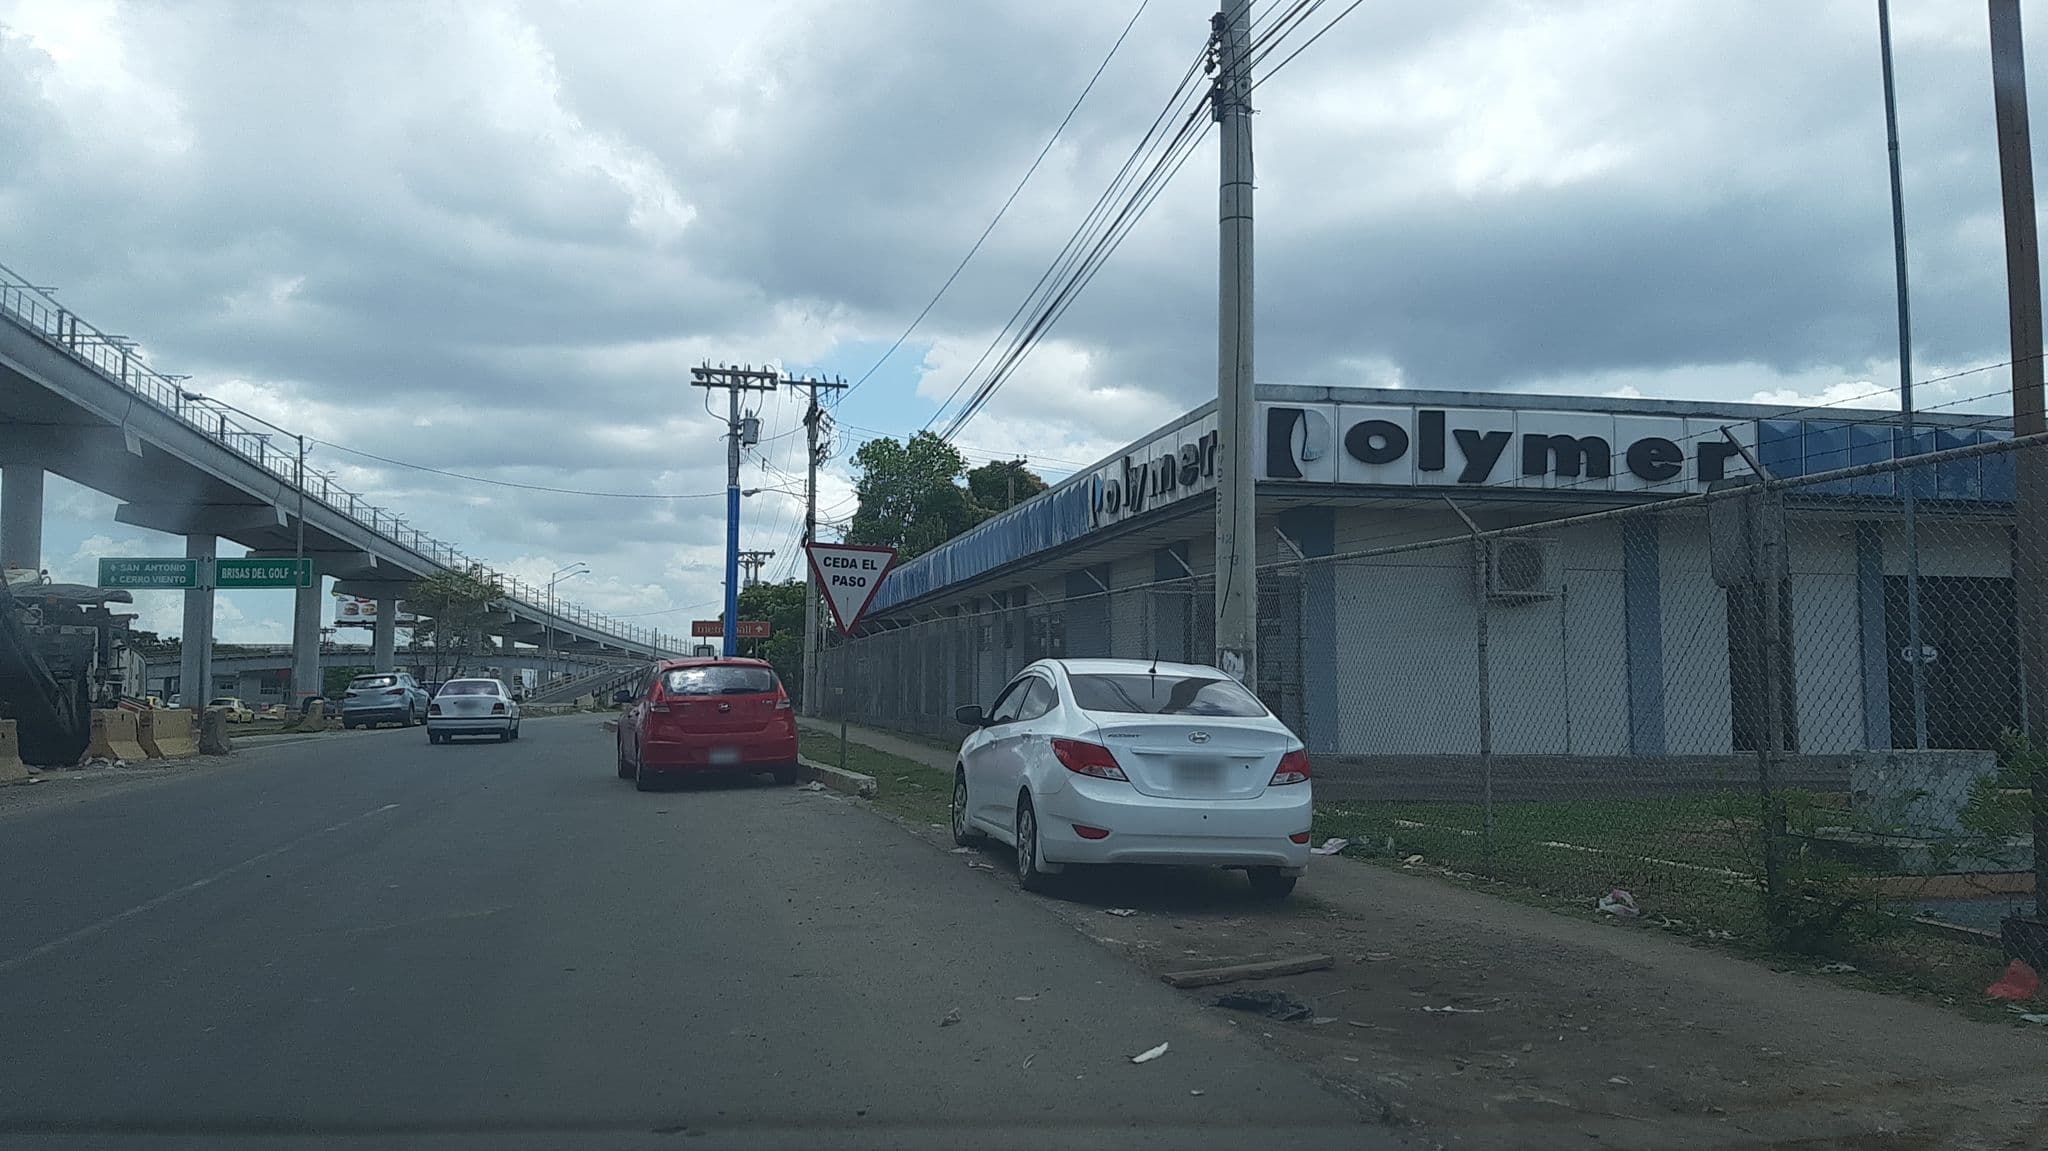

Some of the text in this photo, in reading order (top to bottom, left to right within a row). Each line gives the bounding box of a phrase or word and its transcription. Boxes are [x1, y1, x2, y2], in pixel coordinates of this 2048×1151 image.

[1267, 406, 1738, 483] Polymer
[1091, 429, 1218, 528] Polymer
[119, 564, 186, 572] SAN ANTONIO
[823, 556, 878, 570] CEDA EL
[119, 575, 186, 583] CERRO VIENTO
[221, 567, 289, 579] BRISAS DEL GOLF
[831, 574, 866, 588] PASO
[696, 625, 752, 634] metrall
